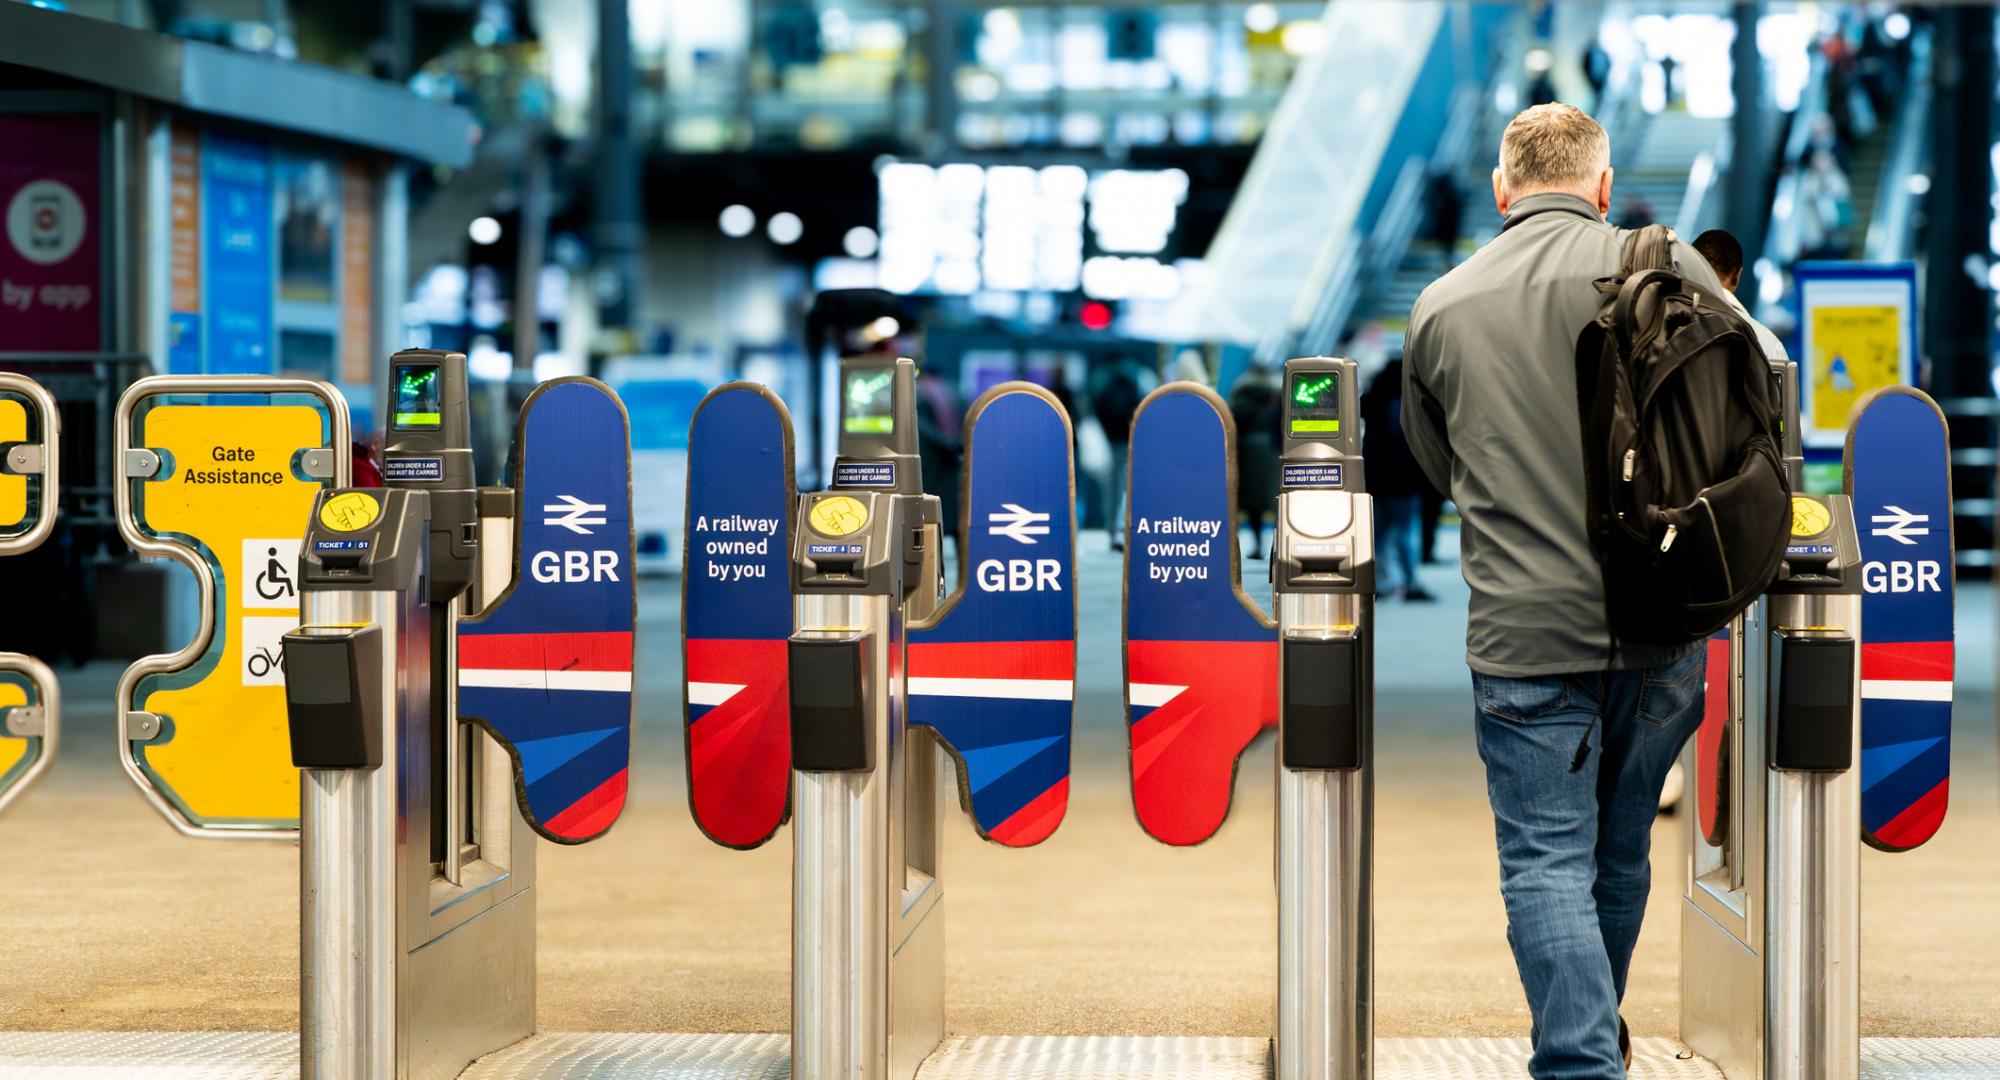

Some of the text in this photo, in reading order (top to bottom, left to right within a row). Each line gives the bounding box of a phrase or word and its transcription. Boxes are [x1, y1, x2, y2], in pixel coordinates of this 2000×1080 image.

[2, 278, 91, 311] by app
[212, 446, 255, 461] Gate
[184, 468, 283, 484] Assistance
[696, 514, 779, 536] A railway
[1137, 516, 1221, 538] A railway
[318, 541, 369, 549] TICKET 51
[706, 538, 768, 555] owned
[811, 545, 838, 553] TICKET
[1147, 540, 1210, 557] owned
[530, 550, 620, 584] GBR
[708, 560, 766, 582] by you
[976, 558, 1062, 593] GBR
[1149, 561, 1208, 584] by you
[1862, 560, 1942, 594] GBR
